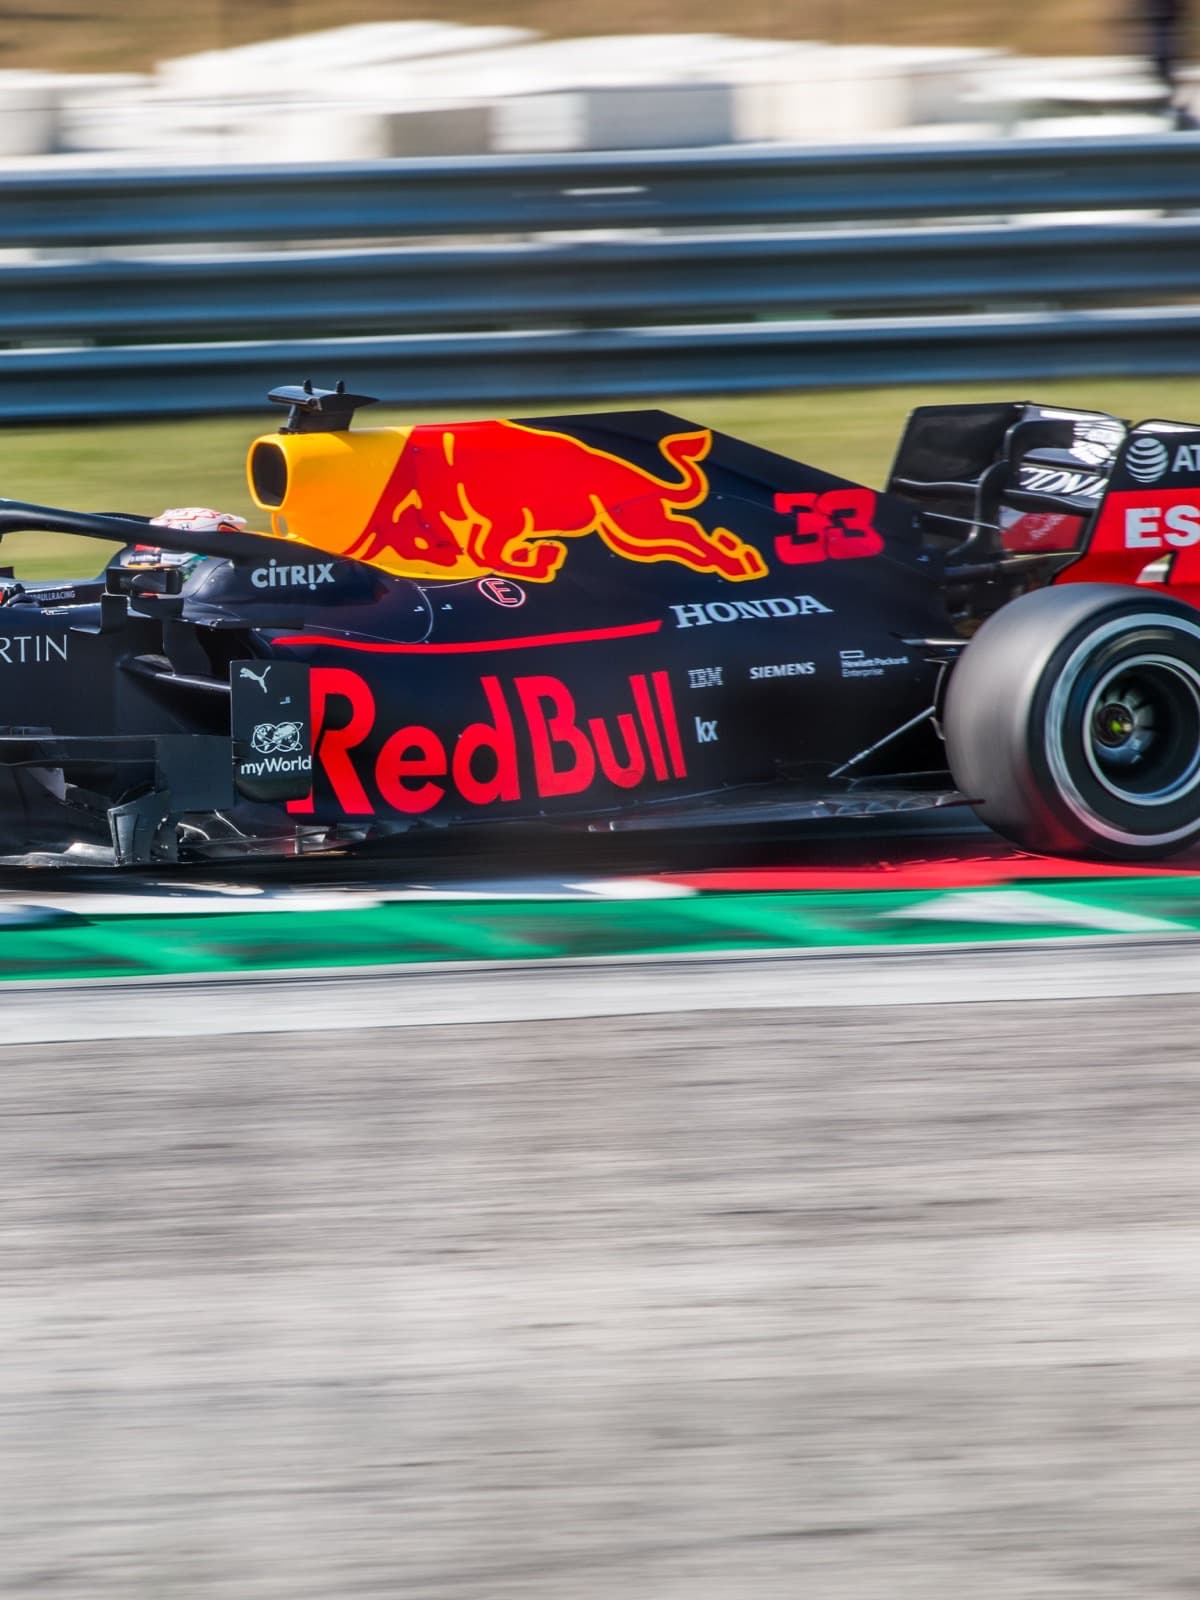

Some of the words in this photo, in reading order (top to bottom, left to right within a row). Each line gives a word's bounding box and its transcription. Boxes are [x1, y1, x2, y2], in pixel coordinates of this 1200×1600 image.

[774, 488, 885, 565] 33
[1125, 504, 1200, 548] ES
[669, 595, 834, 629] HONDA
[688, 667, 724, 688] IBM
[750, 662, 816, 679] SIEMENS
[240, 755, 313, 776] myWorld
